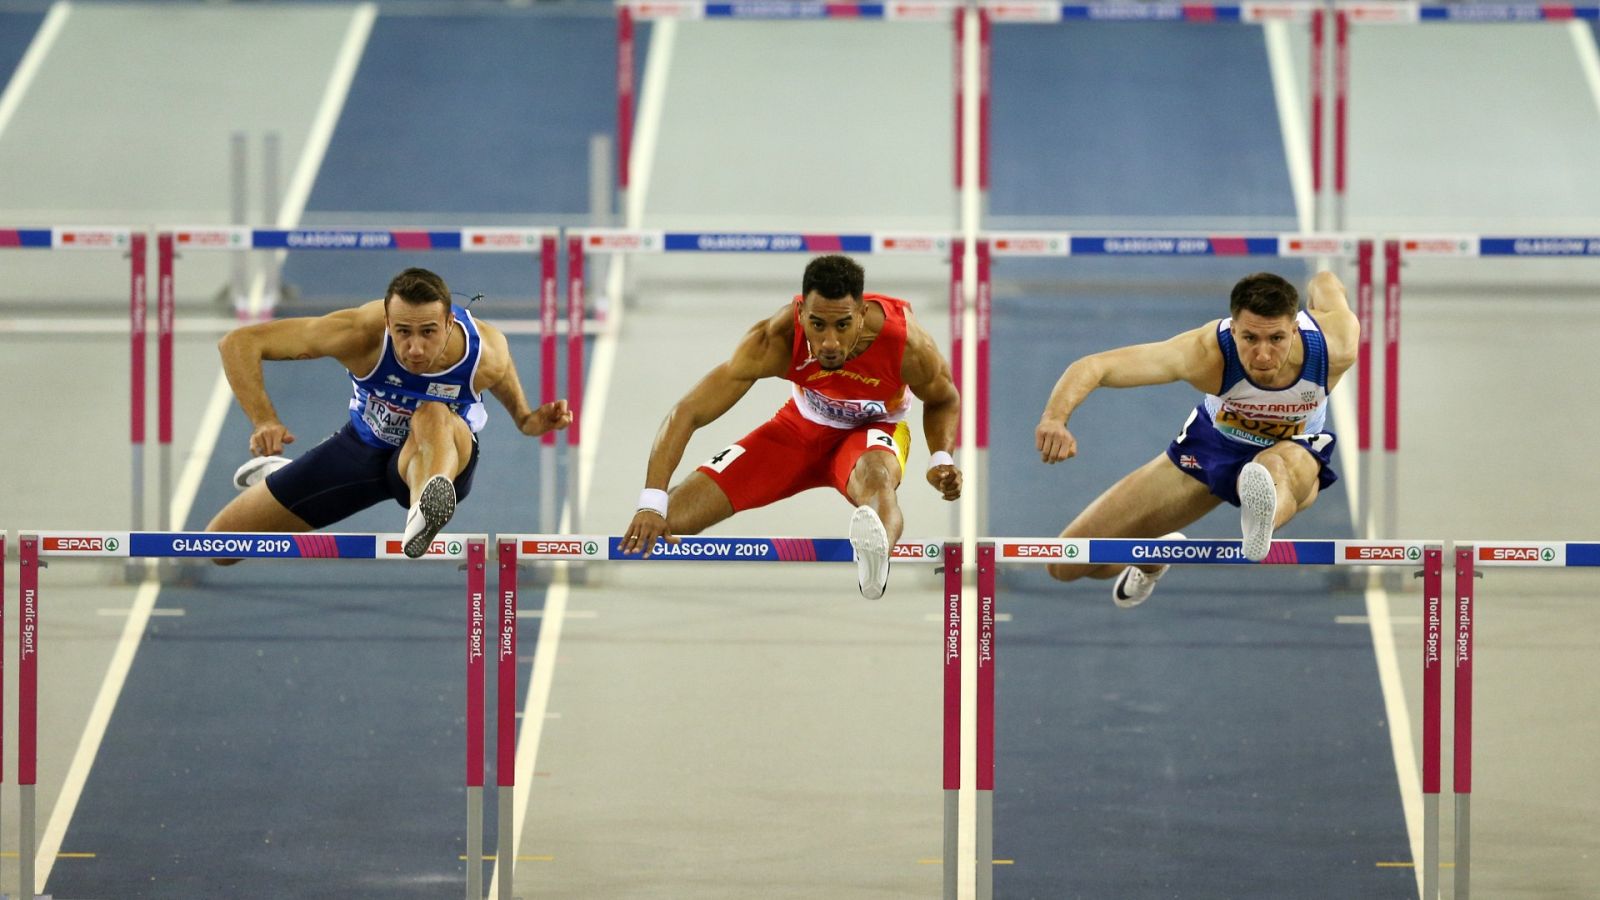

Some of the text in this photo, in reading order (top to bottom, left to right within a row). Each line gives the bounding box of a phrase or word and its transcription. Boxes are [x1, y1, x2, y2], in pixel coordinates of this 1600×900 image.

[1268, 401, 1318, 413] BRITAIN
[1236, 429, 1254, 441] RUN
[1255, 436, 1275, 446] CLEA
[711, 448, 732, 465] 4
[57, 539, 102, 550] SPAR
[172, 539, 291, 552] GLASGOW 2019
[537, 543, 581, 553] SPAR
[652, 543, 769, 556] GLASGOW 2019
[892, 546, 923, 556] PAR
[1017, 545, 1063, 557] SPAR
[1131, 546, 1247, 559] GLASGOW 201
[1360, 548, 1404, 559] SPAR
[1493, 549, 1538, 560] SPAR
[23, 624, 35, 654] Sport
[470, 628, 483, 657] Sport
[501, 626, 513, 655] Sport
[947, 629, 959, 659] Sport
[980, 632, 992, 661] Sport
[1427, 632, 1439, 662] Sport
[1457, 632, 1469, 662] Sport
